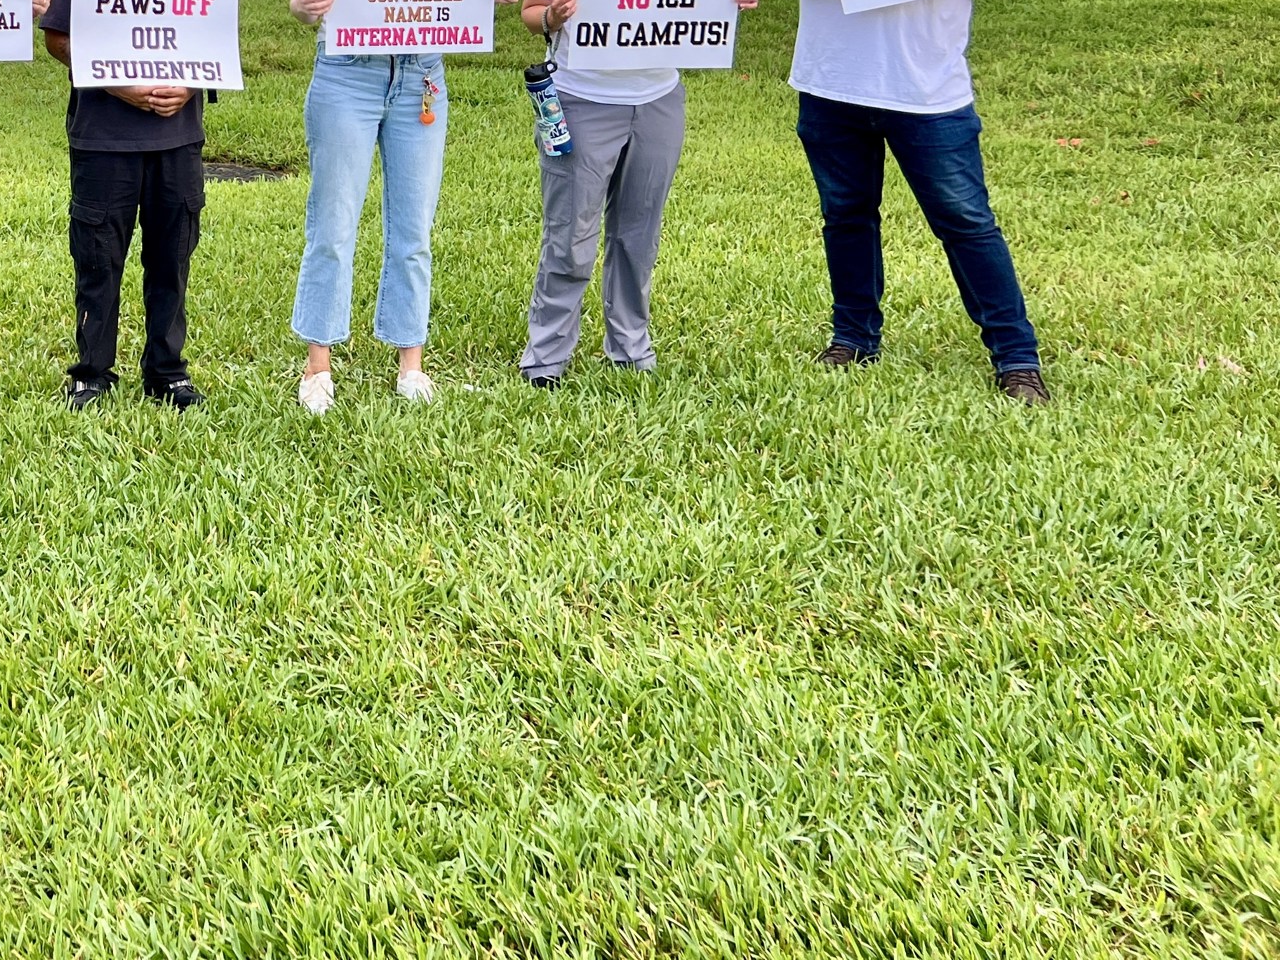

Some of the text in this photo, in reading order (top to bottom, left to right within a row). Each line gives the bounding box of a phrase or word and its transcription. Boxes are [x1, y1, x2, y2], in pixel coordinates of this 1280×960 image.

[384, 6, 450, 23] NAME IS
[131, 27, 178, 50] OUR
[336, 26, 483, 47] INTERNATIONAL
[576, 21, 729, 47] ON CAMPUS!
[91, 60, 223, 82] STUDENTS!
